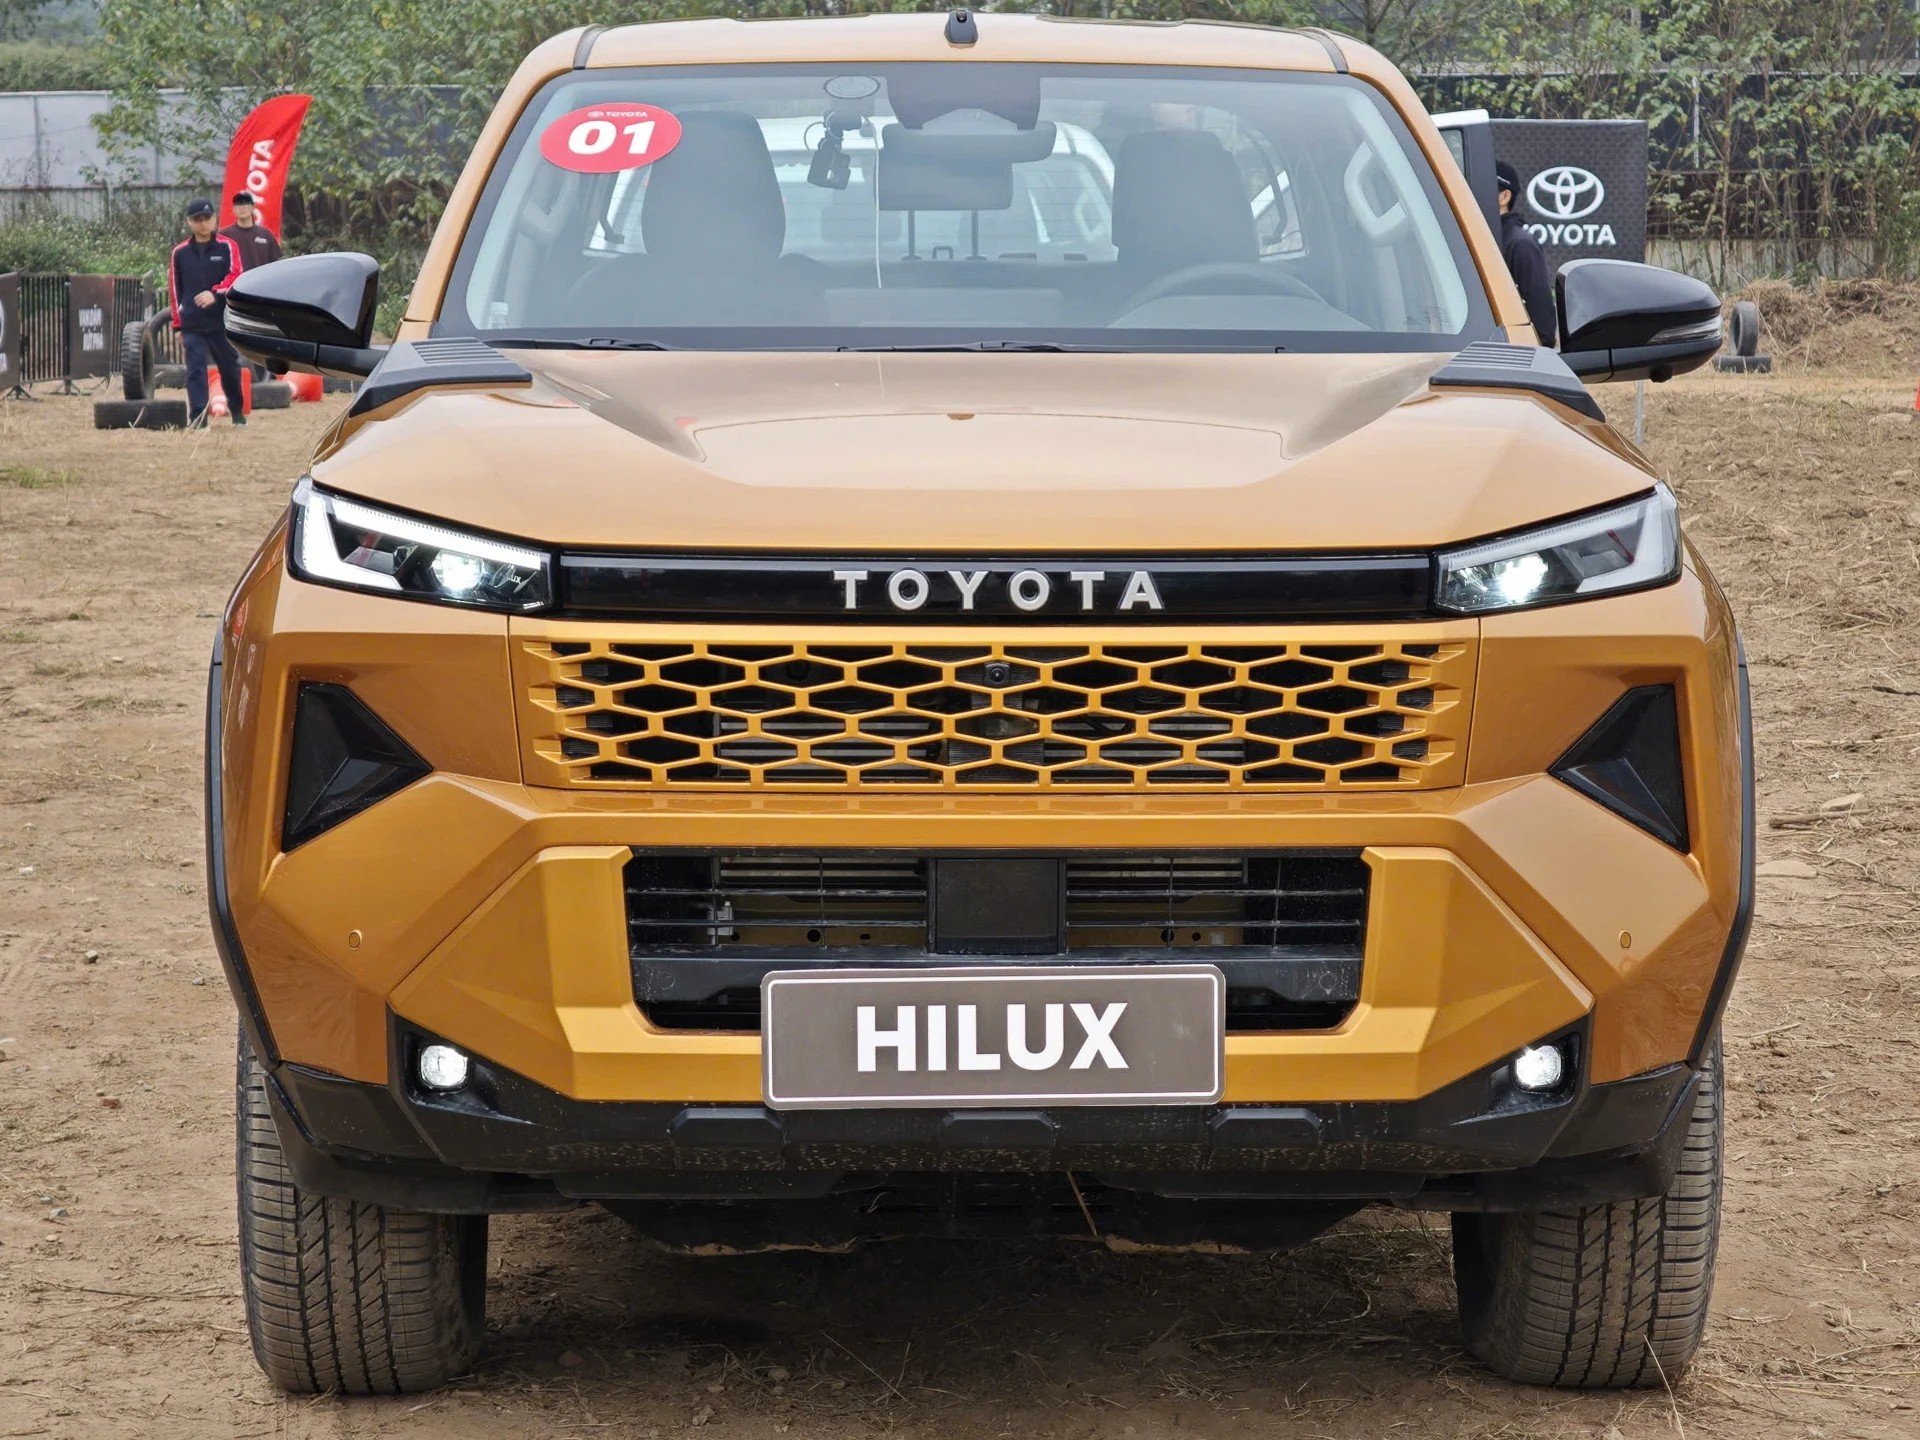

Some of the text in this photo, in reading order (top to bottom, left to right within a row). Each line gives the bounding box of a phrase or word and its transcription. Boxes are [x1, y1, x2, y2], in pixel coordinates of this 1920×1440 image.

[568, 120, 656, 155] 01
[241, 139, 274, 226] YOTA
[1522, 223, 1617, 245] OYOTA
[832, 569, 1164, 611] TOYOTA
[856, 1002, 1130, 1072] HILUX
